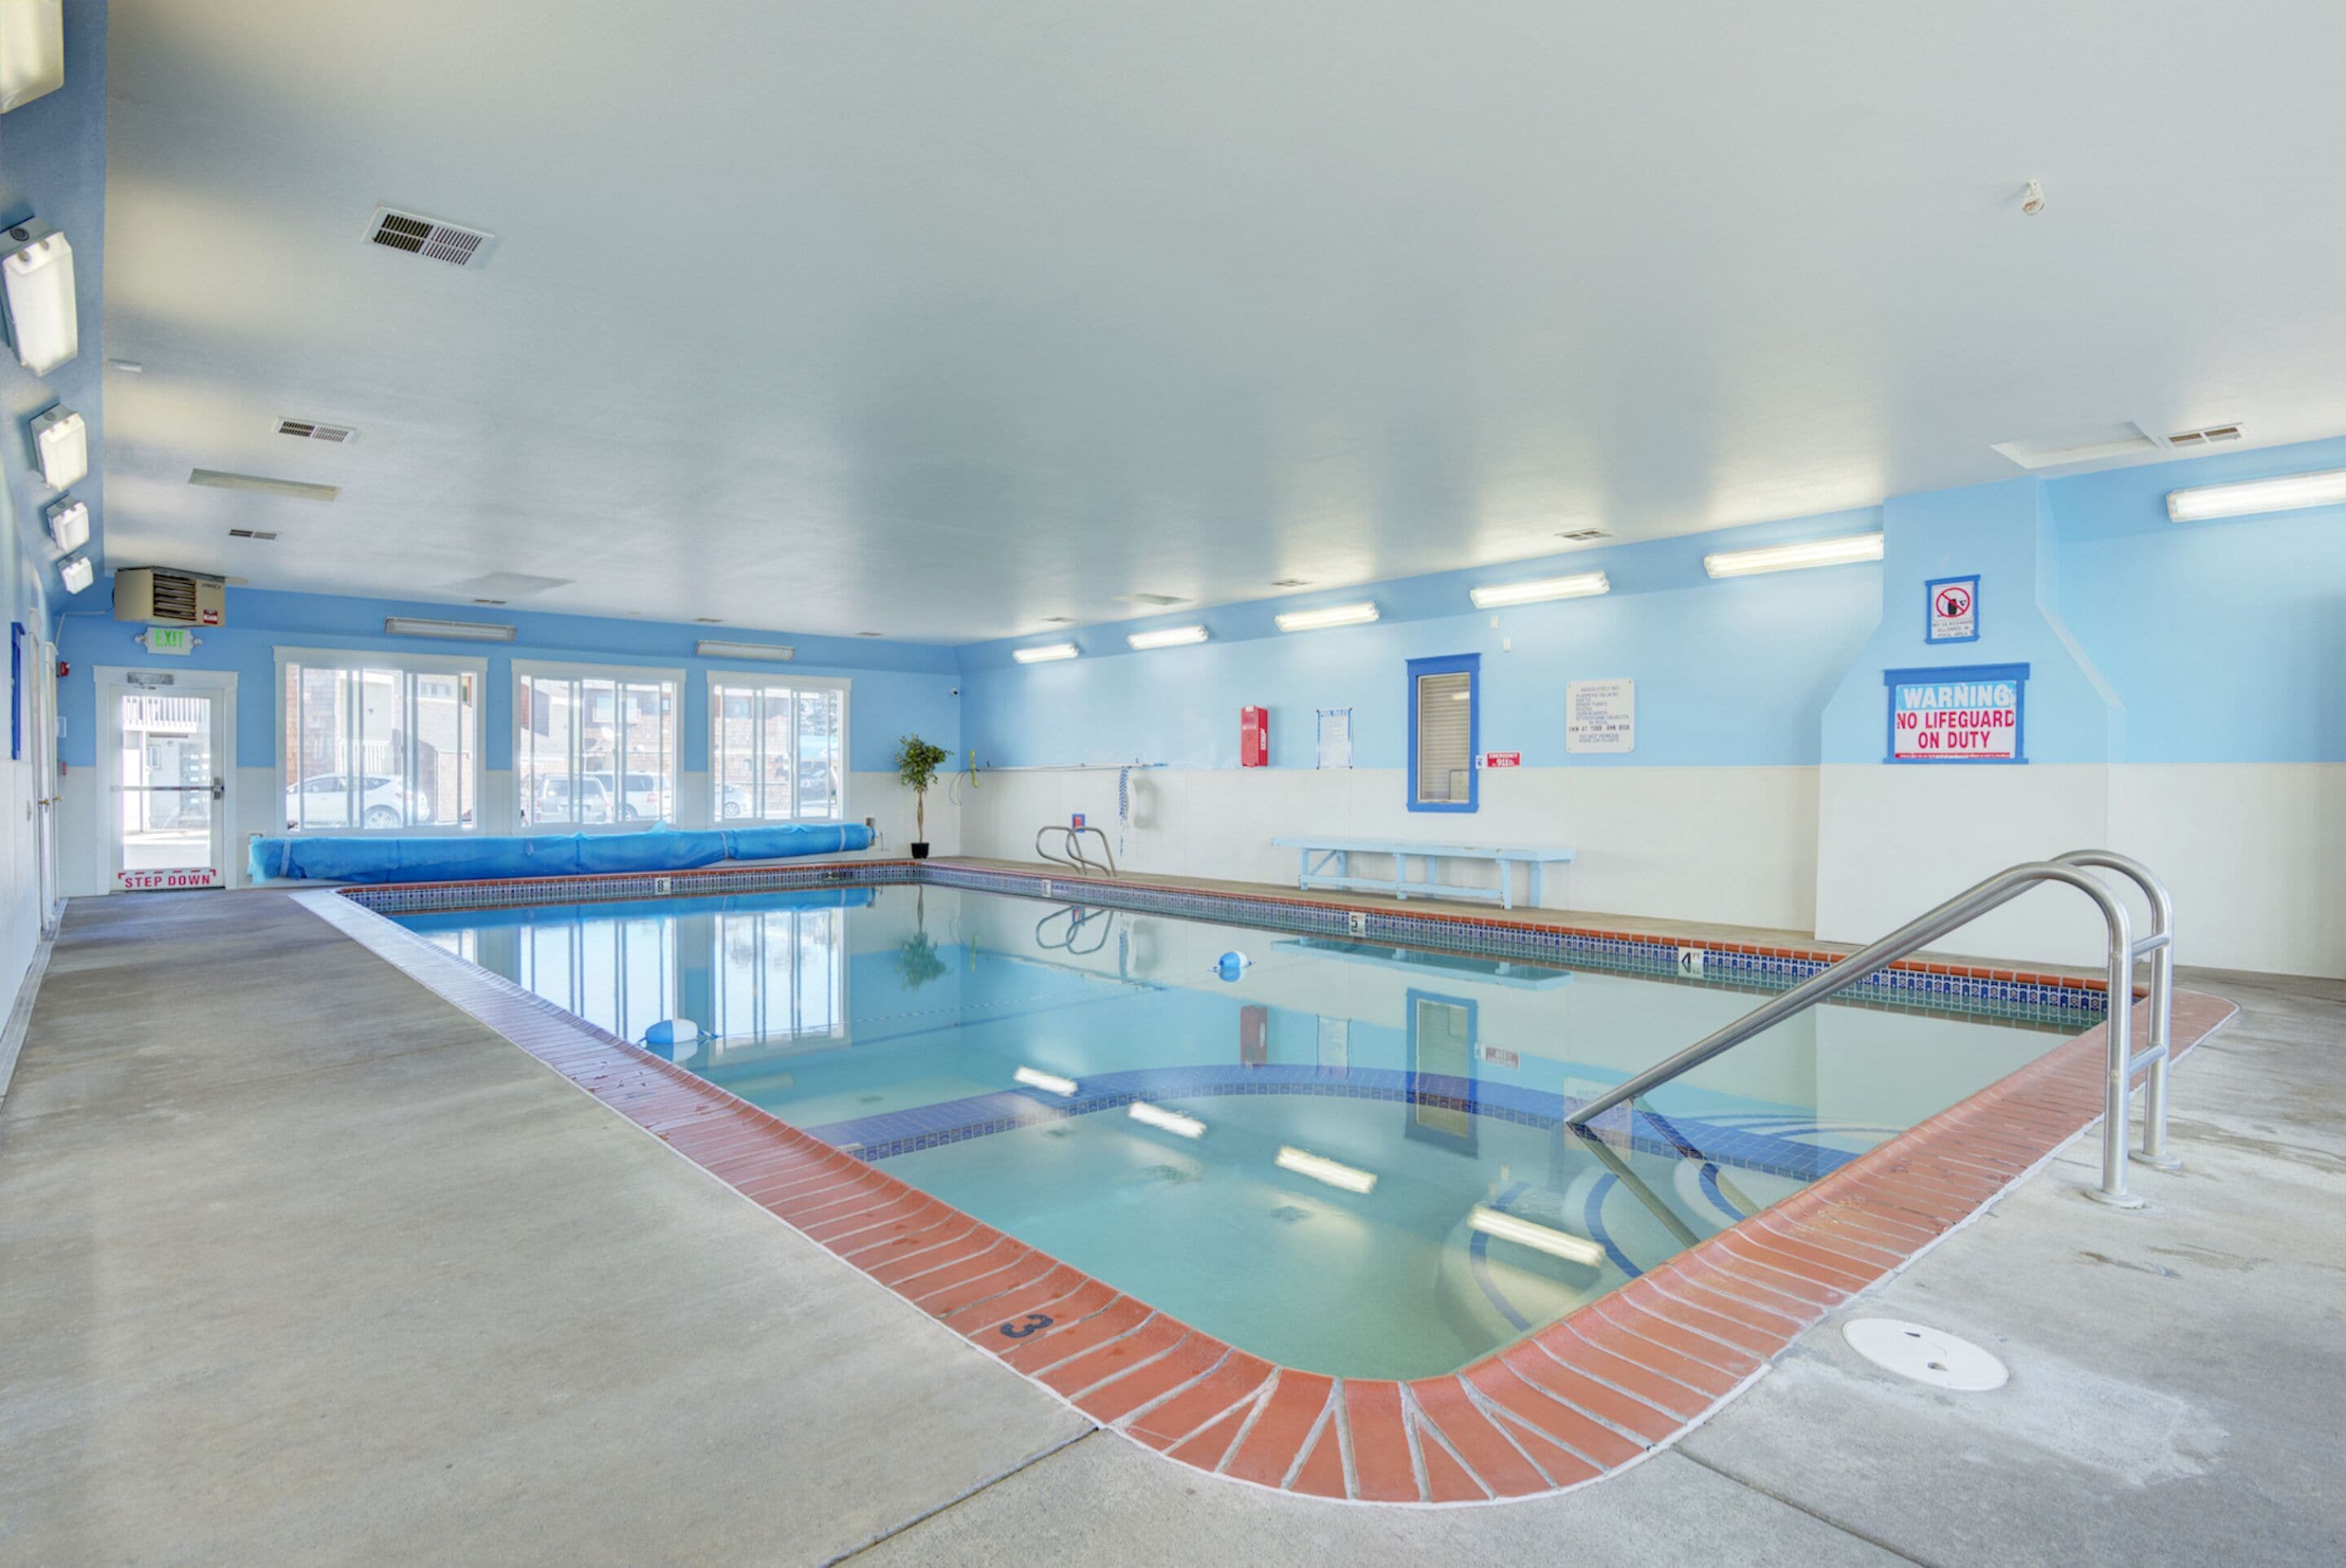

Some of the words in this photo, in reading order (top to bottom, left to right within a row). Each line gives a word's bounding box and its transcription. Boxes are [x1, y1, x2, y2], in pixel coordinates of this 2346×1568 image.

[156, 630, 183, 647] EXIT
[1903, 683, 2014, 709] WARNING
[1897, 712, 1918, 730] NO
[1925, 709, 2014, 729] LIFEGUARD
[1918, 731, 1940, 749] ON
[1948, 731, 1991, 749] DUTY
[125, 876, 162, 889] STEP
[168, 875, 210, 886] DOWN
[999, 1314, 1054, 1338] 3
